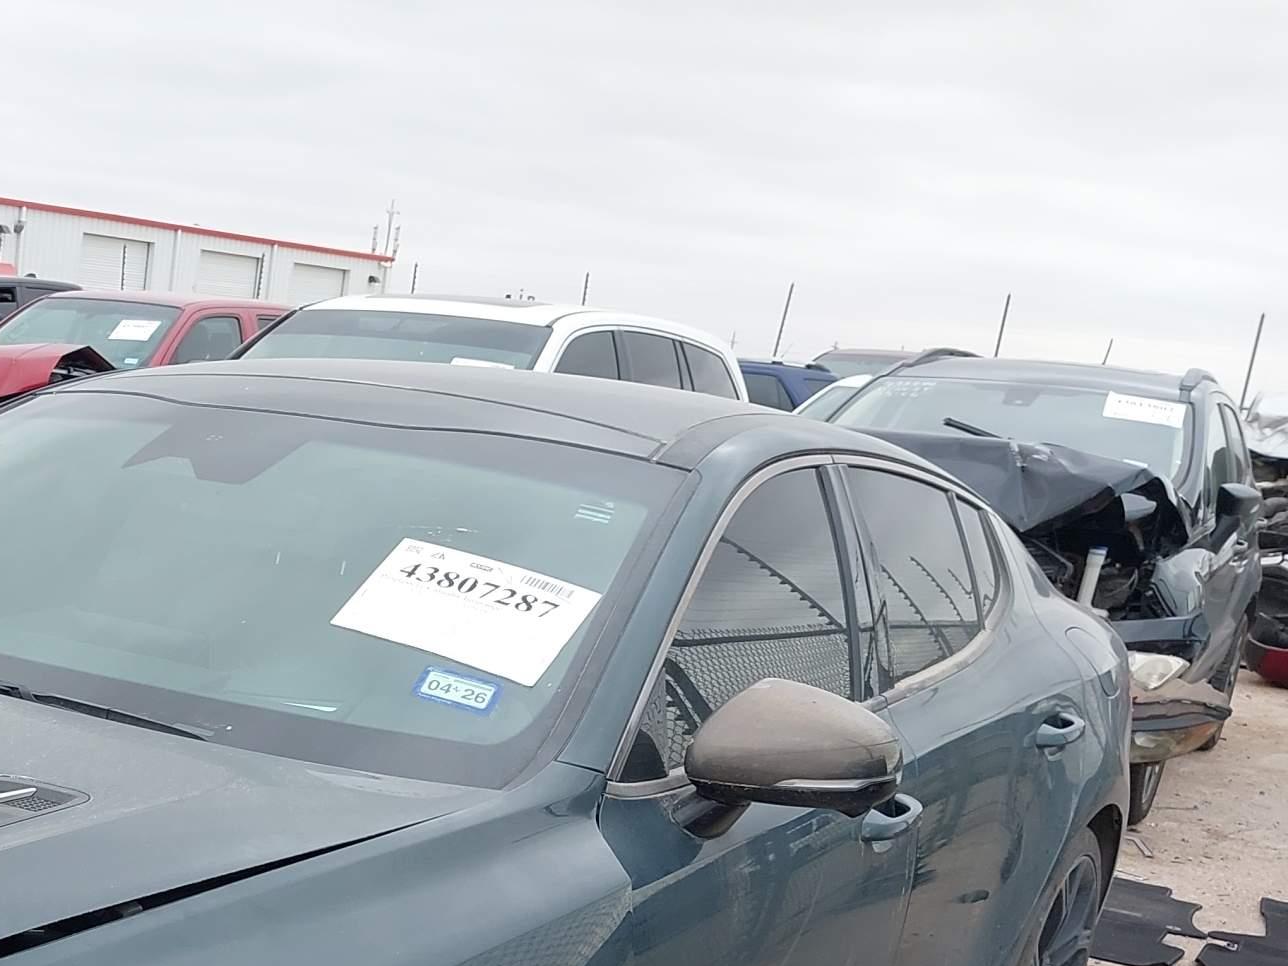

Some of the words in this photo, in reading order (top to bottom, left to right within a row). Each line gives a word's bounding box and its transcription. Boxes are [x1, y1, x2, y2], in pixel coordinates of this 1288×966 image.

[400, 562, 560, 618] 43807287
[427, 678, 451, 696] 04
[463, 687, 487, 705] 26
